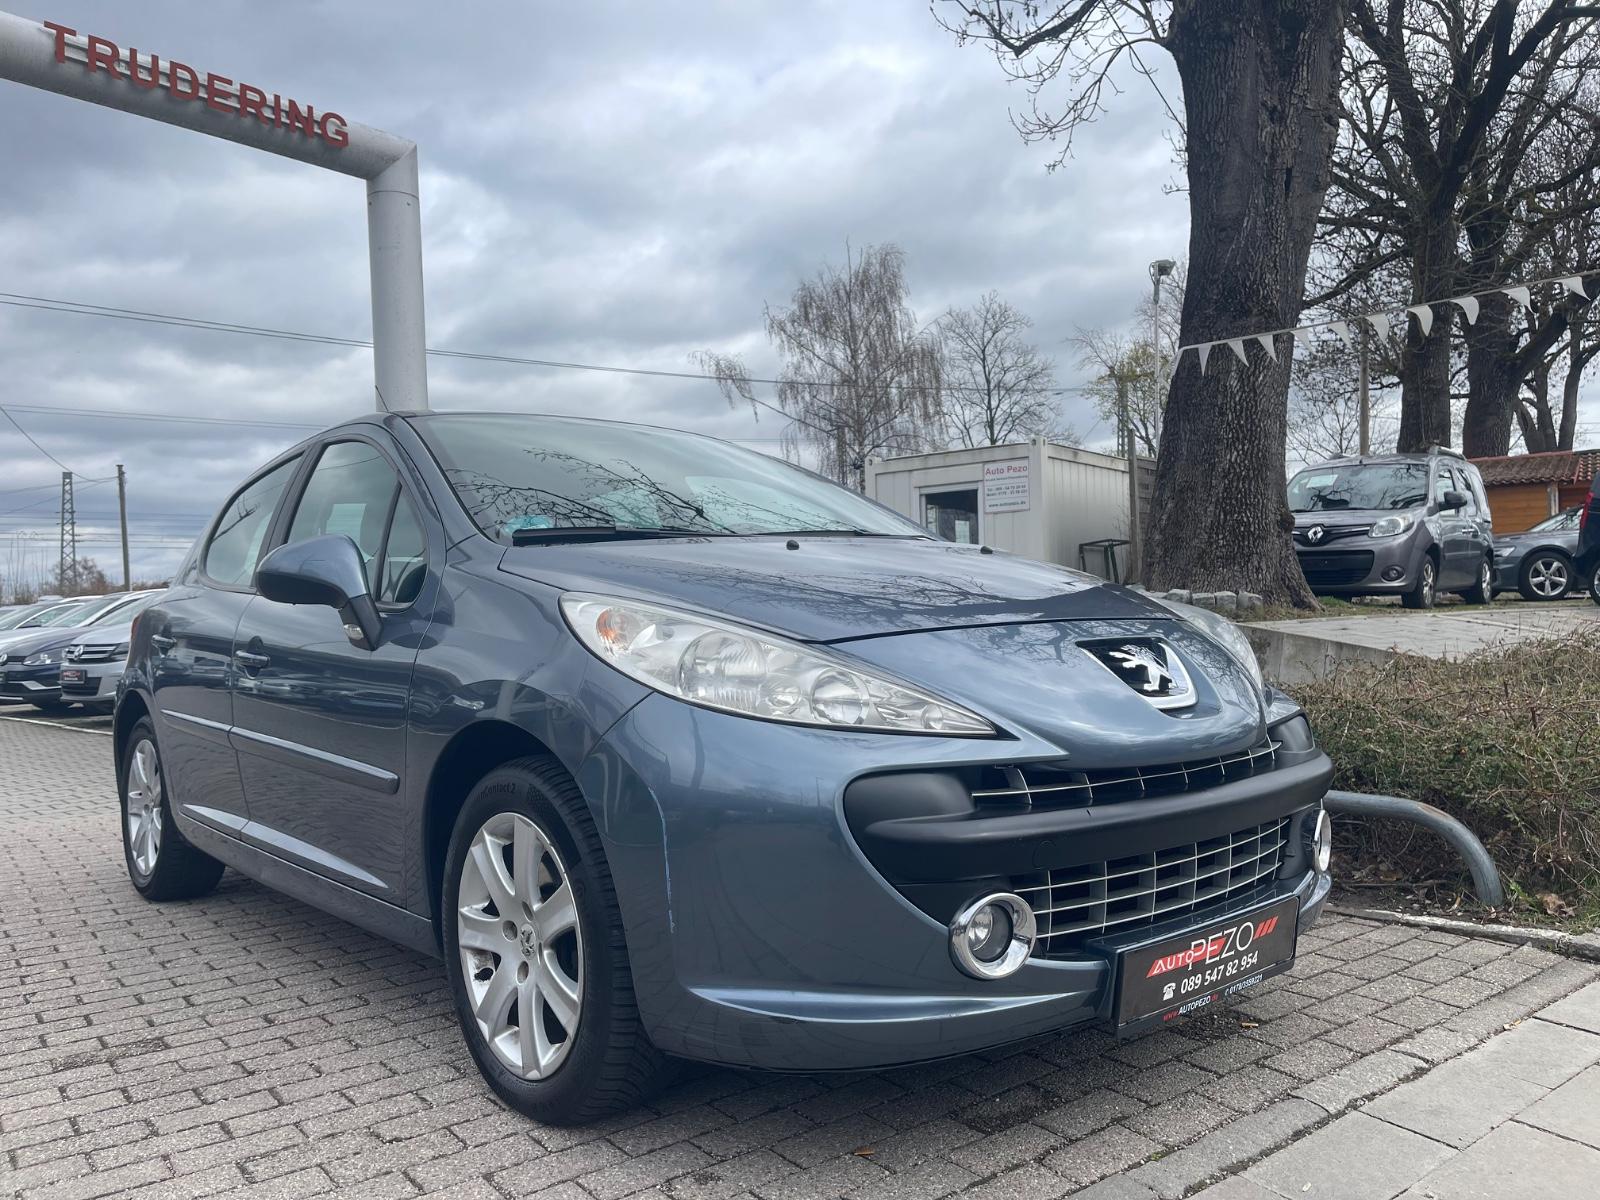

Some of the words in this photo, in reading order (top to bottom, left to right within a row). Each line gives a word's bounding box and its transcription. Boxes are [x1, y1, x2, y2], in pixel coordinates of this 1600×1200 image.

[43, 20, 349, 148] TRUDERING
[985, 467, 1005, 476] Auto
[1006, 465, 1028, 473] Pezo
[1180, 973, 1201, 994] 089
[1204, 966, 1224, 987] 547
[1225, 959, 1238, 977] 82
[1240, 950, 1259, 971] 954
